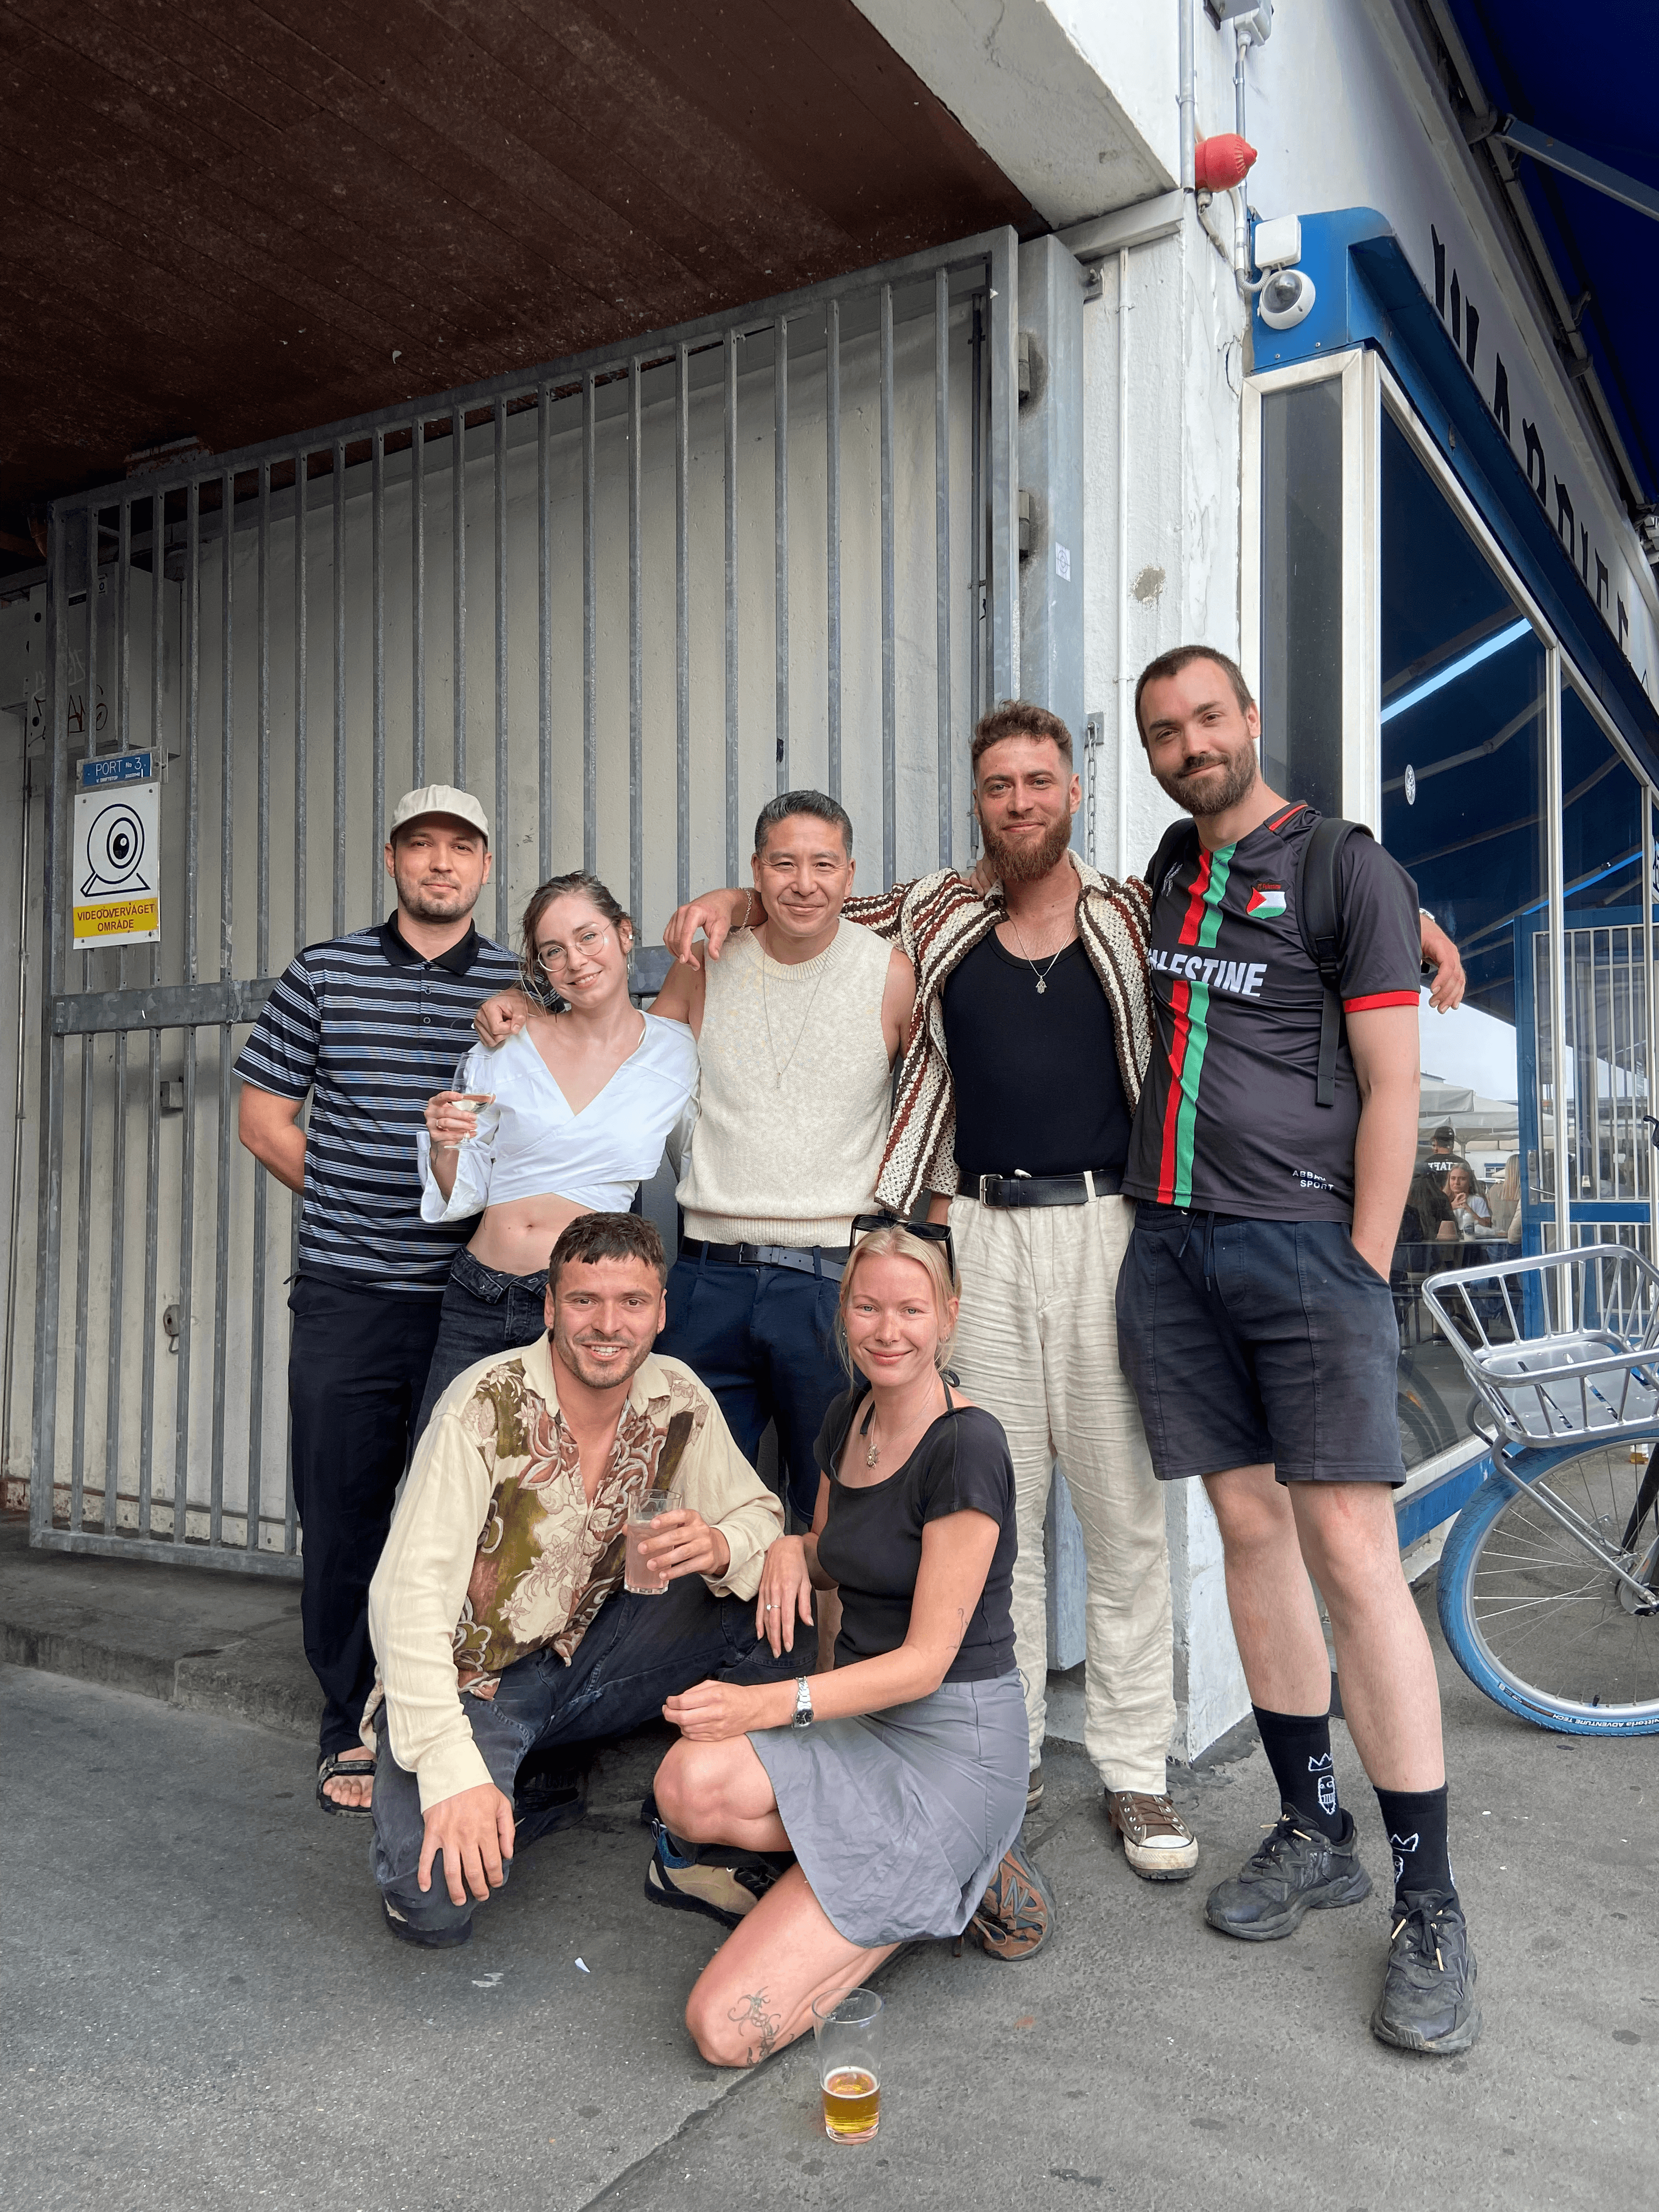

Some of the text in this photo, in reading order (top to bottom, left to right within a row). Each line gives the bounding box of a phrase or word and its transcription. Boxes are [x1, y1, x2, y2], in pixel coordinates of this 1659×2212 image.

[95, 759, 123, 776] PORT
[134, 757, 142, 770] 3
[1148, 947, 1268, 997] ALESTINE
[1300, 1179, 1335, 1191] SPORT
[1552, 1713, 1573, 1723] TECH
[1575, 1719, 1624, 1728] ADVENTURE
